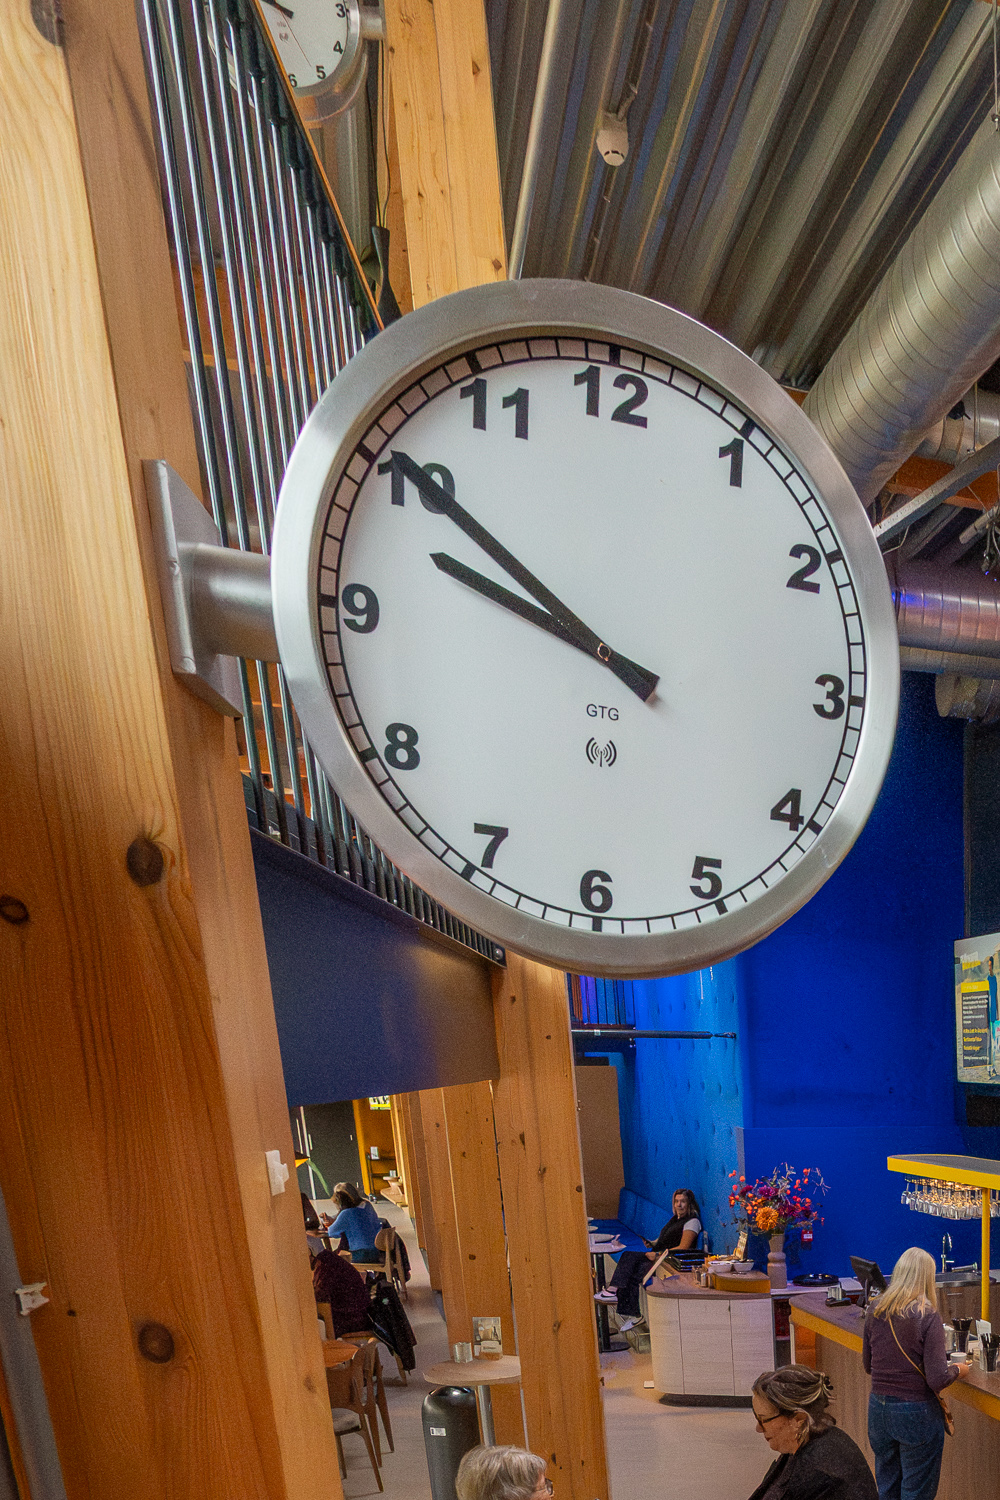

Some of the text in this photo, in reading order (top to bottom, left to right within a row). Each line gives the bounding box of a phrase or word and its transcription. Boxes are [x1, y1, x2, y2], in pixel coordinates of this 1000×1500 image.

[335, 3, 346, 18] 3
[333, 41, 343, 55] 4
[288, 73, 298, 88] 6
[316, 65, 326, 80] 5
[460, 377, 530, 440] 11
[574, 364, 649, 428] 12
[377, 451, 456, 515] 10
[718, 437, 746, 488] 1
[786, 543, 822, 593] 2
[341, 582, 380, 634] 9
[585, 702, 620, 722] GTG
[812, 673, 845, 720] 3
[384, 722, 421, 770] 8
[769, 787, 804, 832] 4
[473, 822, 509, 869] 7
[579, 868, 613, 913] 6
[689, 855, 723, 900] 5
